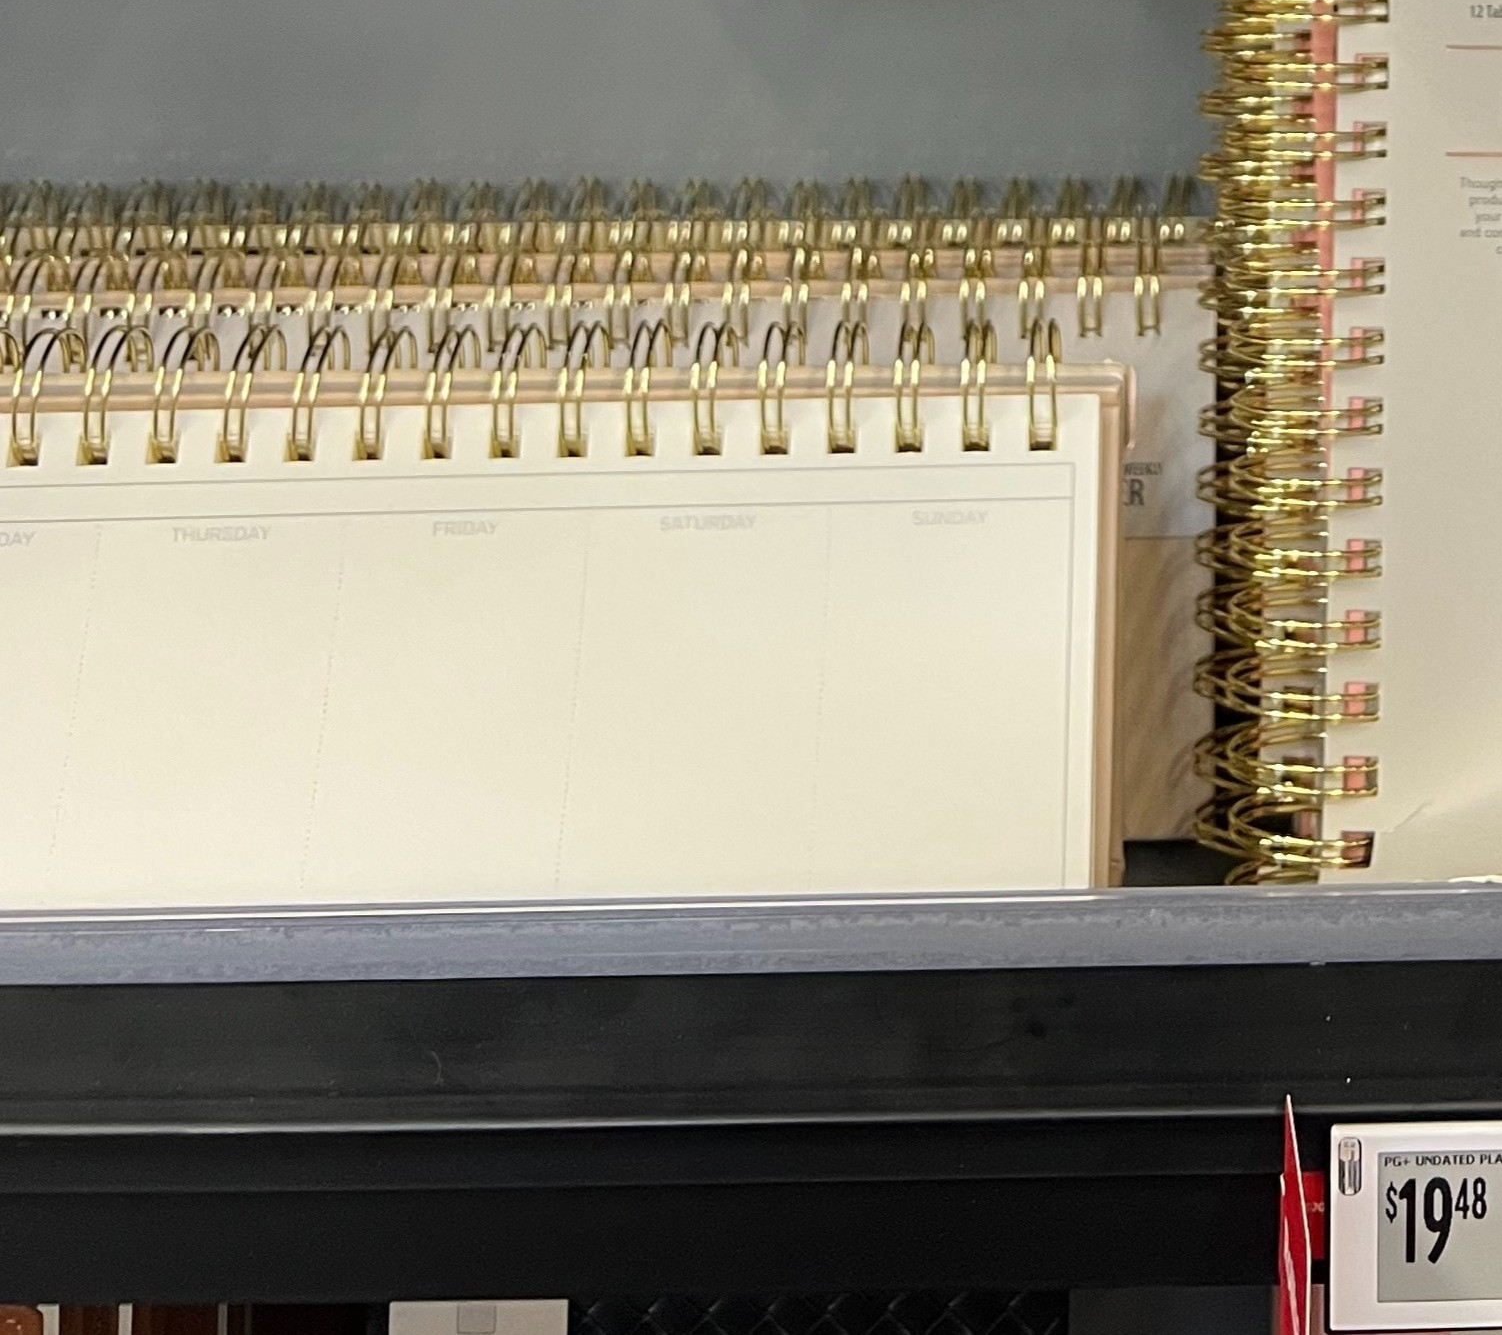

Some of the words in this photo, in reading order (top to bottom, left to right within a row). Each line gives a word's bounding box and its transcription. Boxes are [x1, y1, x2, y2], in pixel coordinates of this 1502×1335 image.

[1470, 5, 1484, 18] 12
[172, 526, 271, 543] THURSDAY
[432, 519, 498, 537] FRIDAY
[659, 513, 756, 532] SATURDAY
[912, 508, 988, 527] SUNDAY
[1384, 1156, 1411, 1168] PG+
[1415, 1154, 1475, 1167] UNDATED
